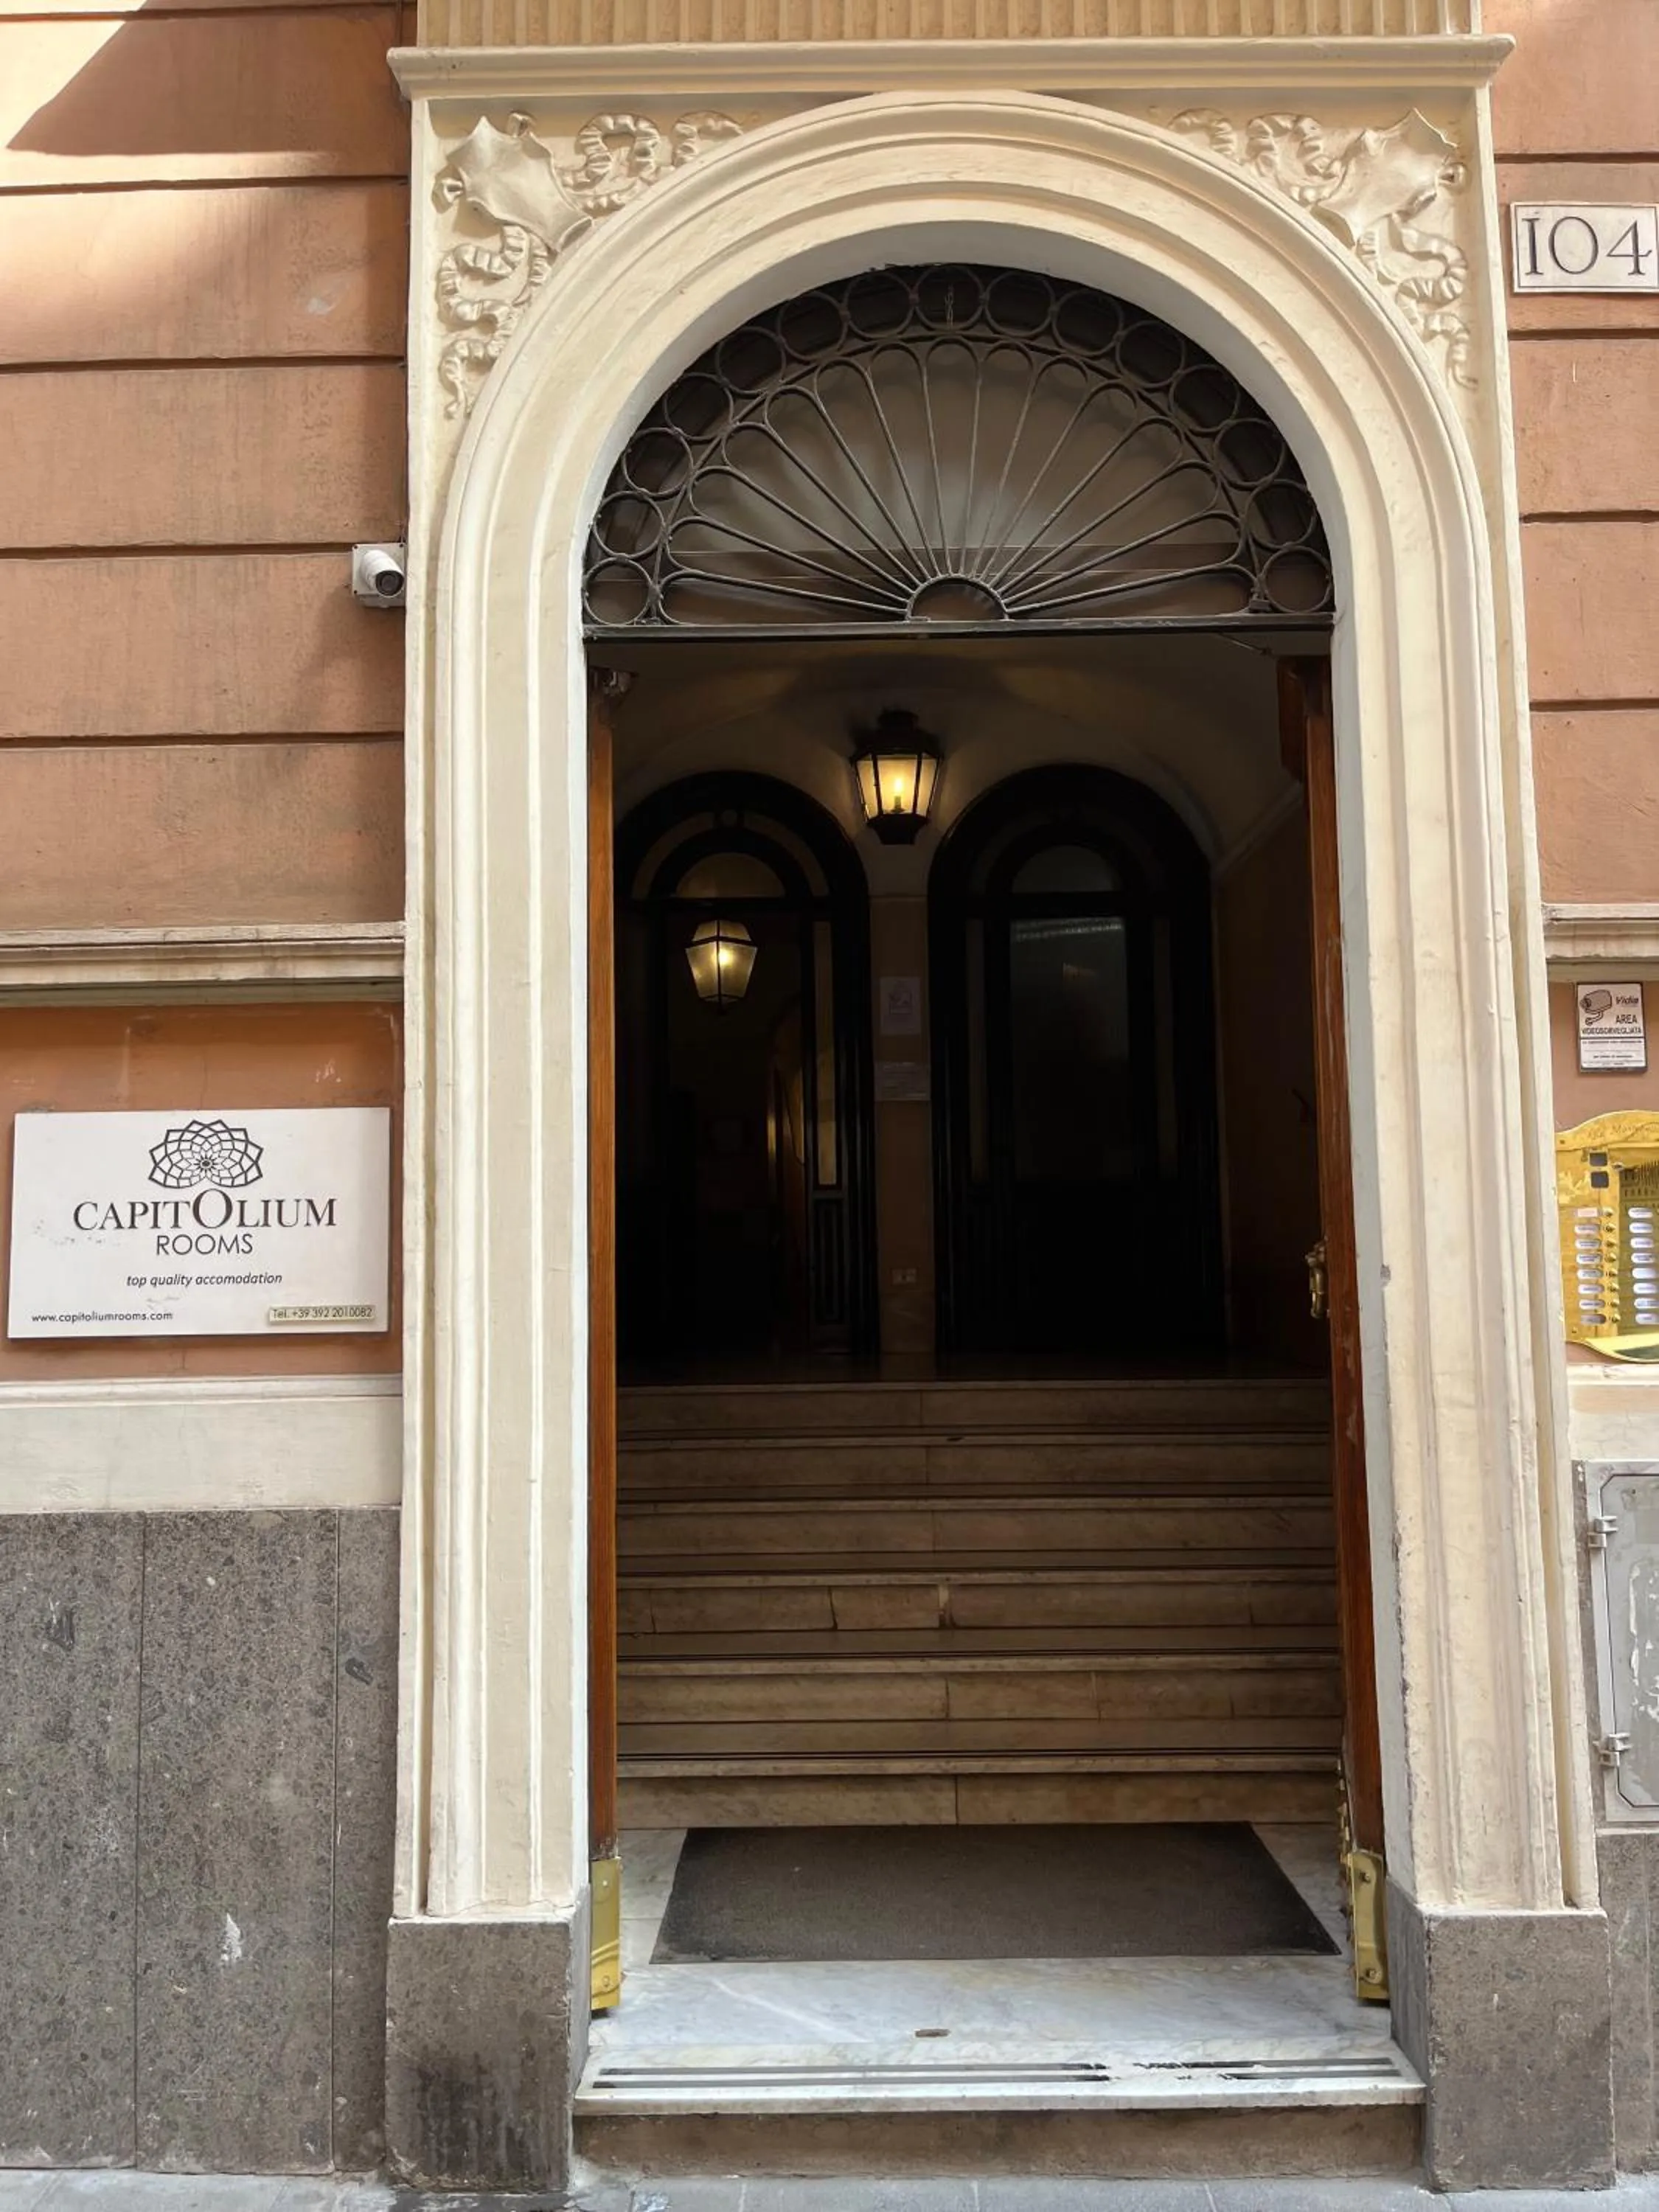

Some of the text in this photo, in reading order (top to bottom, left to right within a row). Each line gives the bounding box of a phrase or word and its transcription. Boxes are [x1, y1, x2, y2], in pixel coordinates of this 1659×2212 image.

[1522, 216, 1652, 276] 104
[1615, 1015, 1638, 1024] AREA
[74, 1189, 336, 1231] CAPITOLIUM
[156, 1234, 252, 1256] ROOMS
[126, 1271, 282, 1288] top quality accomodation
[32, 1311, 173, 1324] www.capitoliumrooms.com
[273, 1310, 290, 1318] Tel.
[293, 1309, 310, 1318] +39
[313, 1309, 330, 1318] 392
